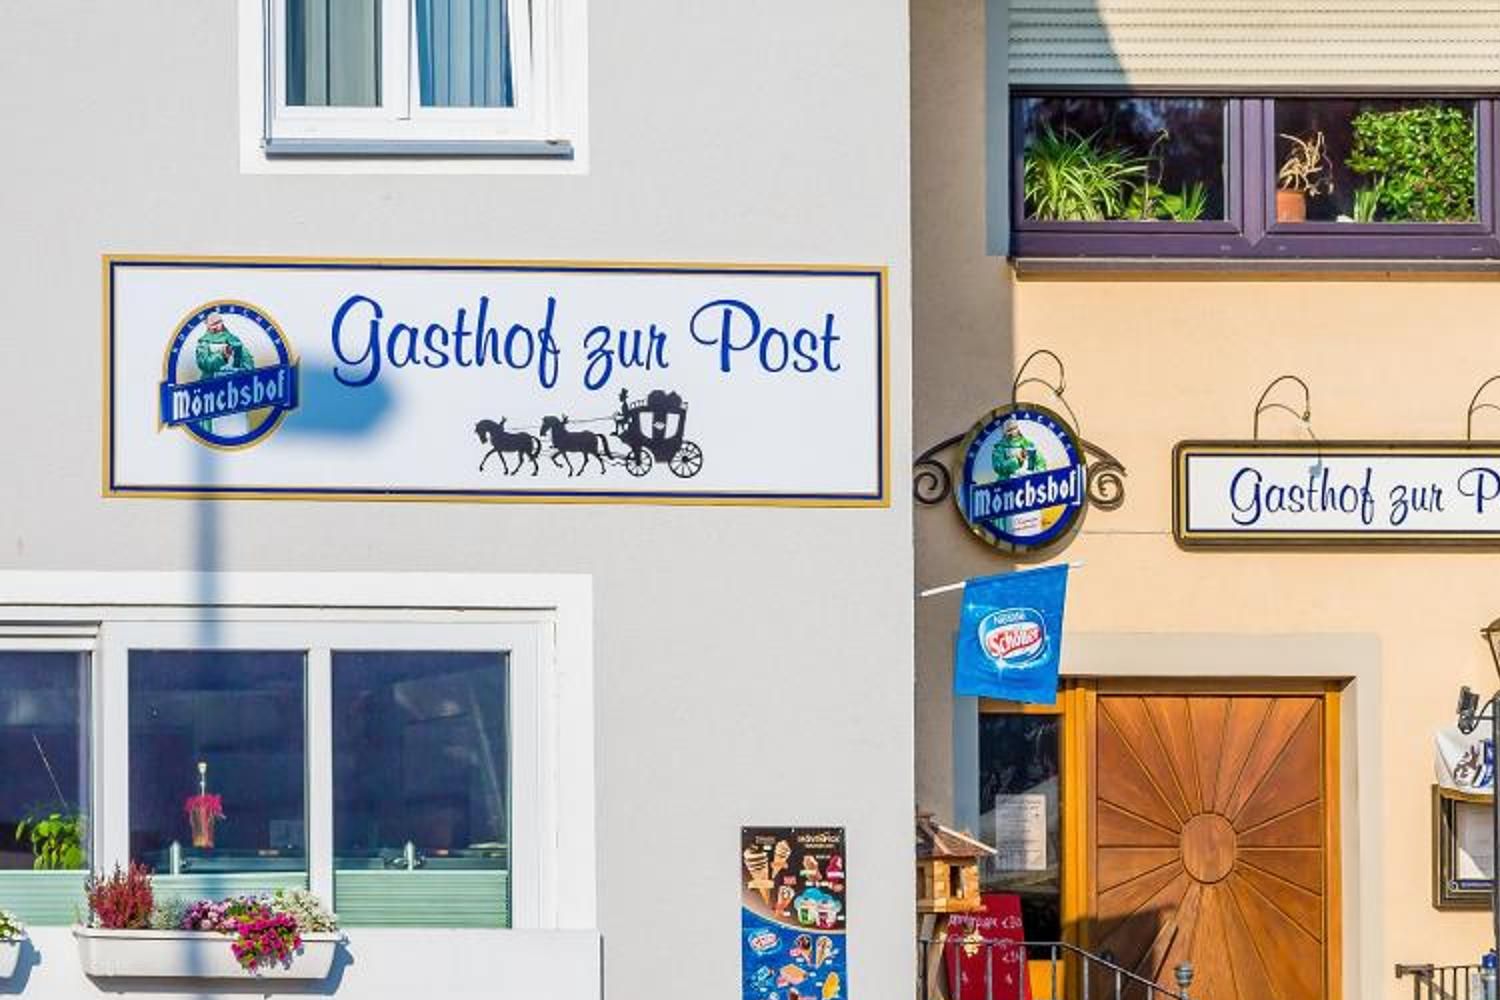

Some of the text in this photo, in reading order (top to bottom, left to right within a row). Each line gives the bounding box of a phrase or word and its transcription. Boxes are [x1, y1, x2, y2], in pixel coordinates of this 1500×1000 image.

[331, 294, 843, 391] Gasthof zur Post
[172, 368, 286, 421] Mönchshof
[974, 468, 1078, 519] Mönchshof
[1229, 465, 1378, 526] Gasthof
[1390, 481, 1446, 525] zur
